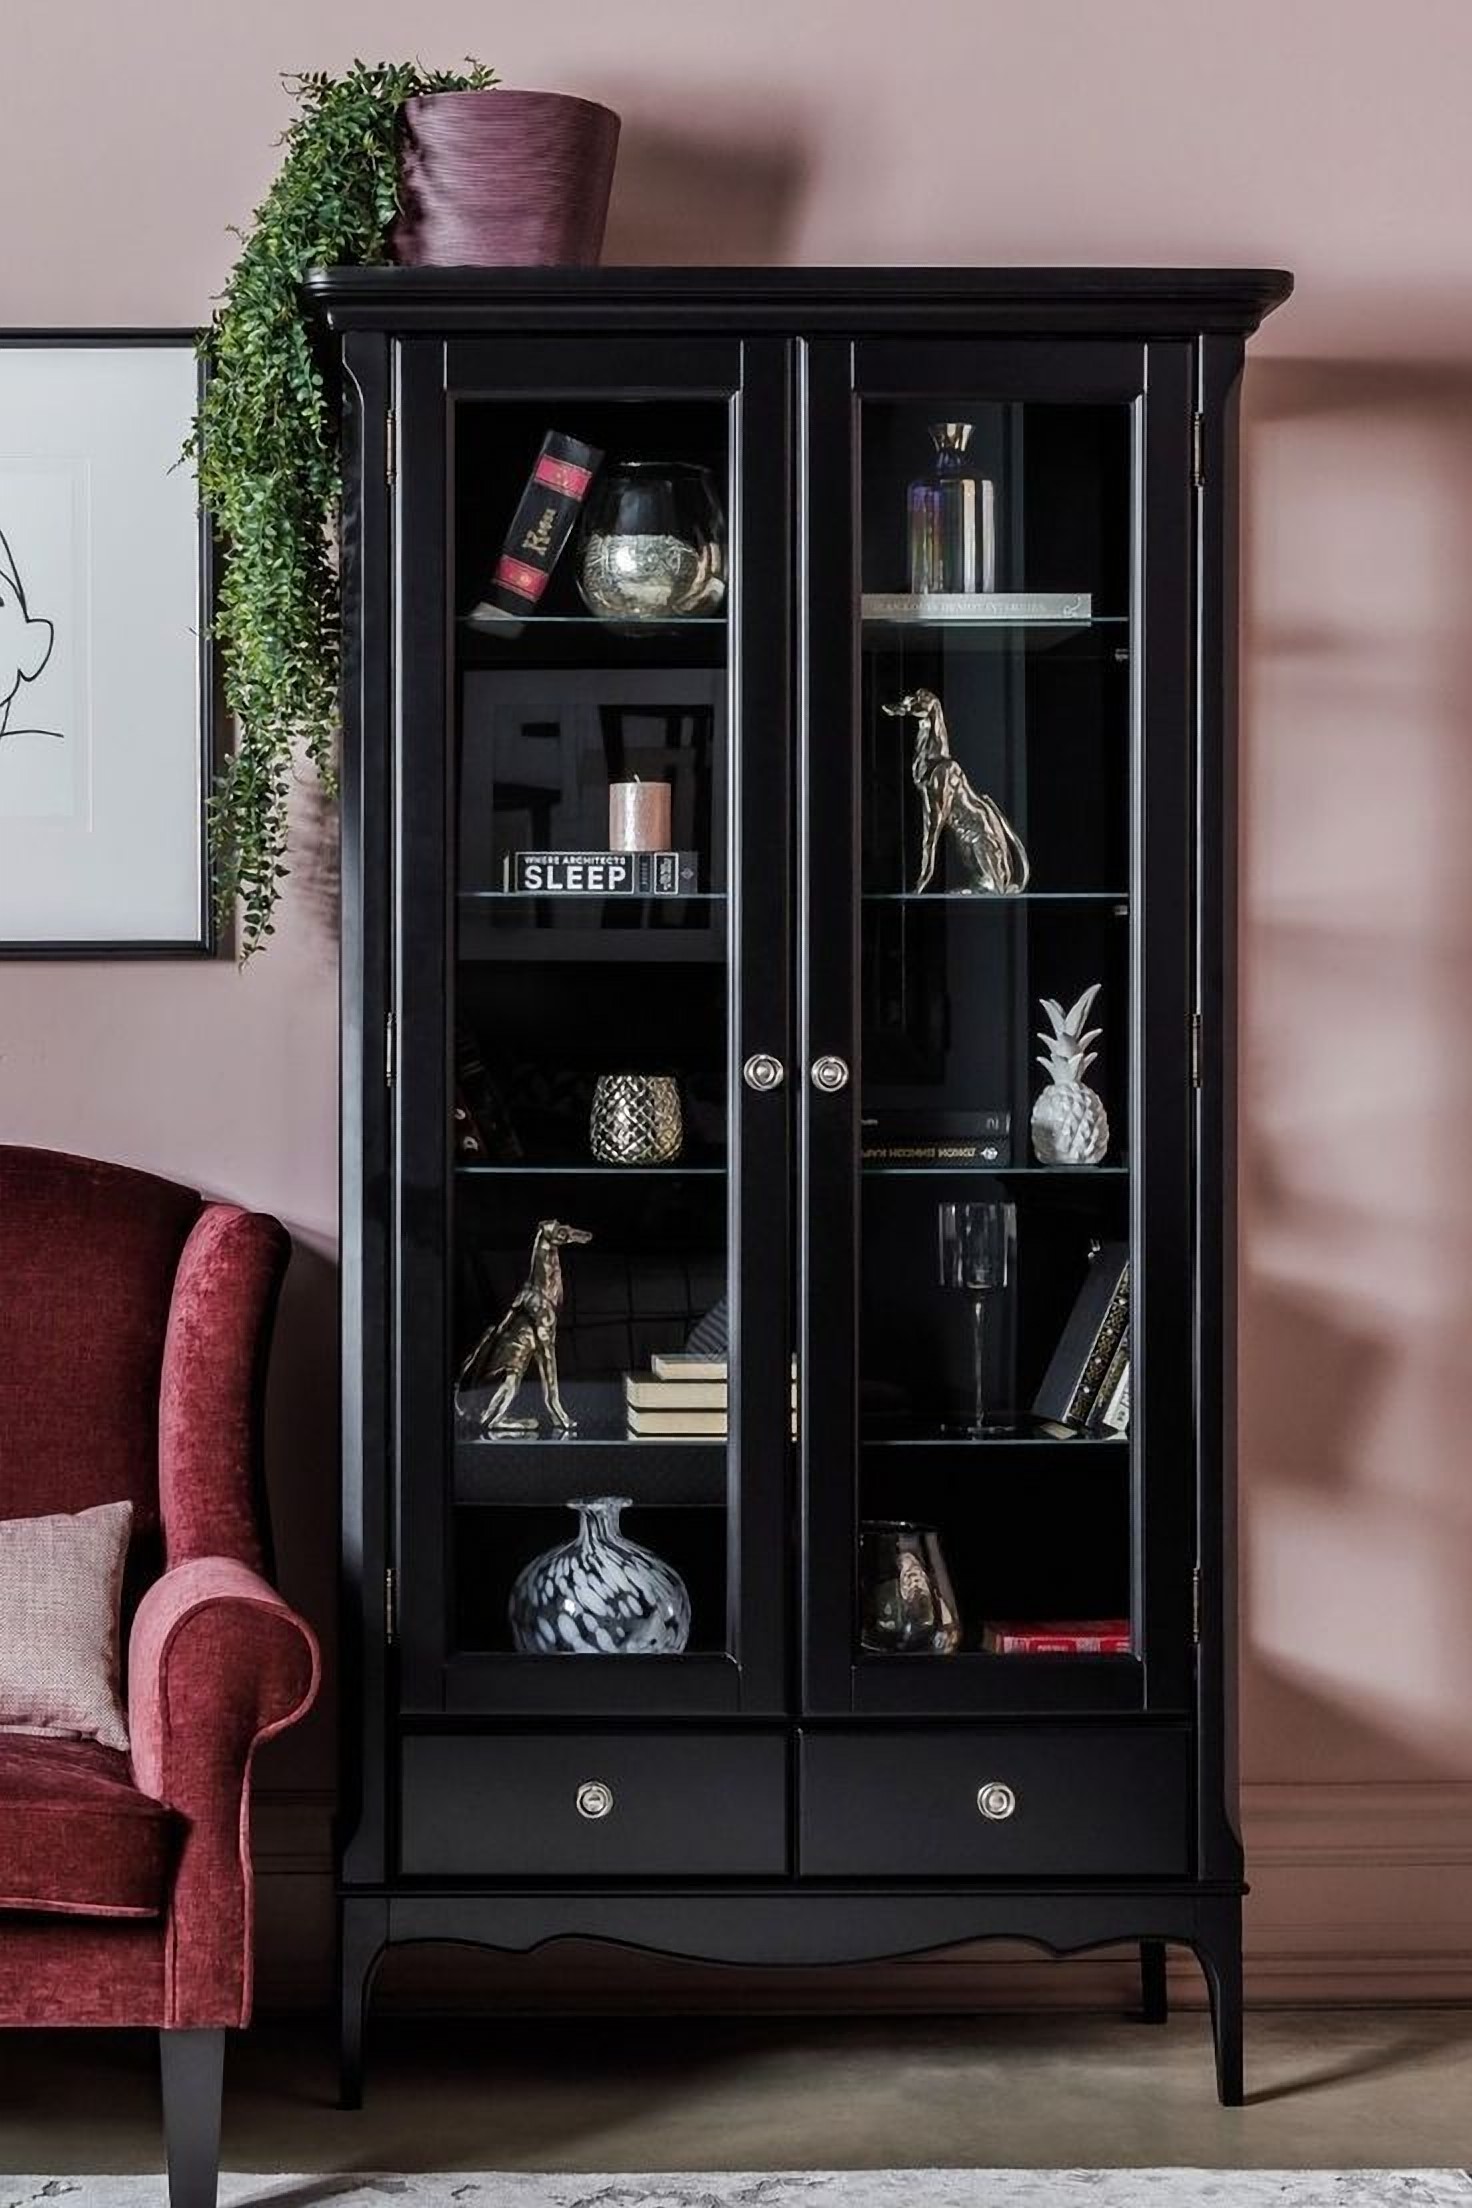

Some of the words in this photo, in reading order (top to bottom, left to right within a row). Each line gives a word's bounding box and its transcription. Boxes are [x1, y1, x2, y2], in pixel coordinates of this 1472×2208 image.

[524, 856, 559, 865] WHERE
[562, 856, 626, 865] ARCHITECTS
[525, 865, 626, 890] SLEEP
